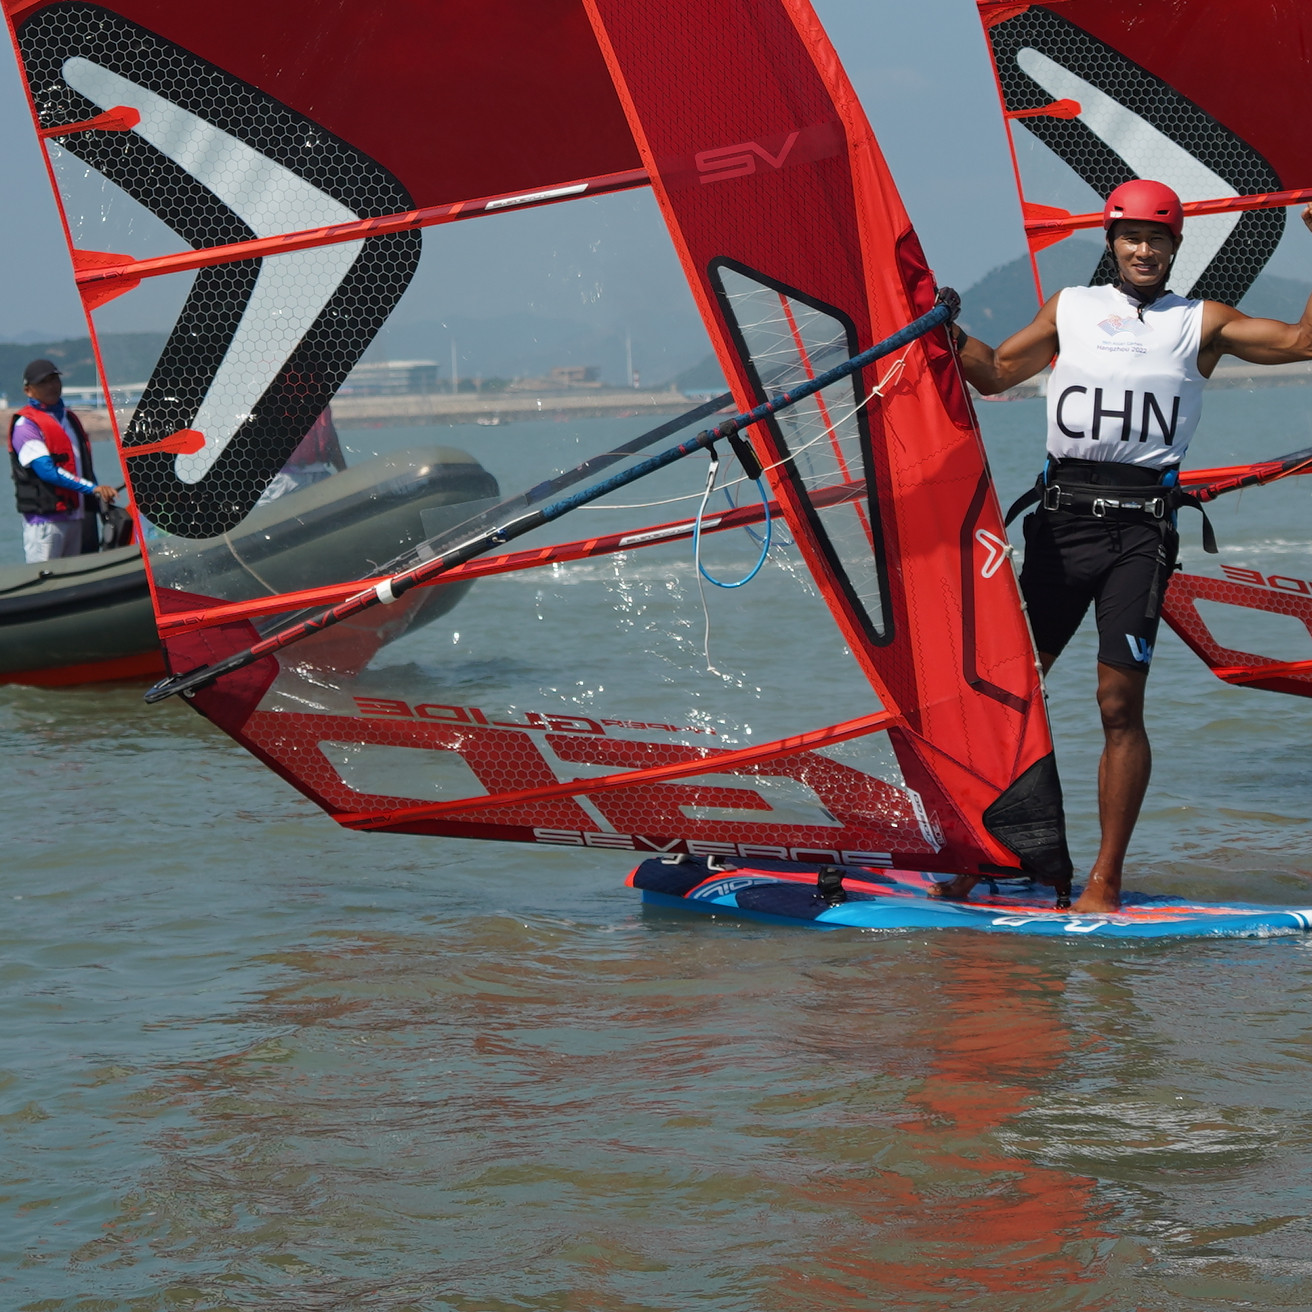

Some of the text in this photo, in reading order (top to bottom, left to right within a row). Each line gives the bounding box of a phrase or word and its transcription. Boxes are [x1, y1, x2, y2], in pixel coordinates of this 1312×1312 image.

[694, 131, 800, 184] SV
[1056, 385, 1181, 446] CHN
[533, 827, 893, 869] SEVERNE
